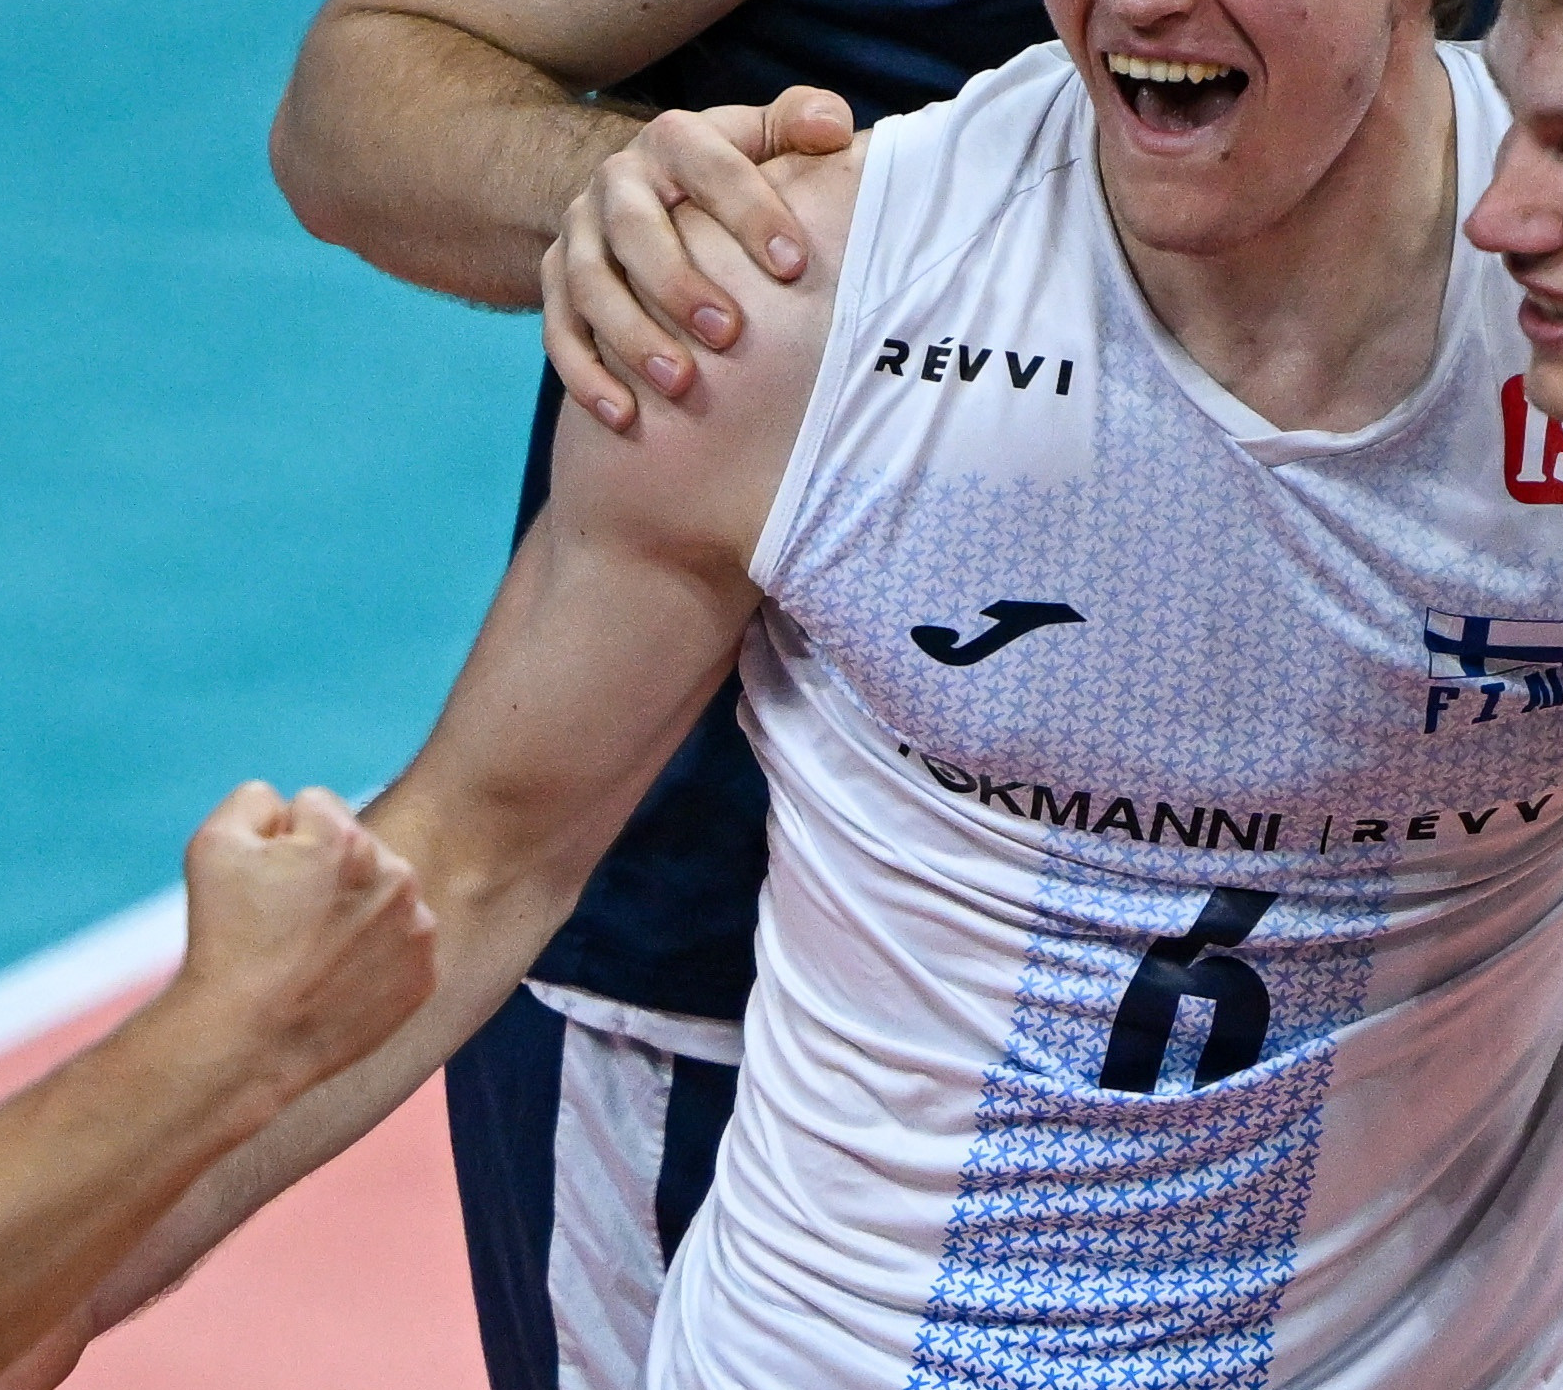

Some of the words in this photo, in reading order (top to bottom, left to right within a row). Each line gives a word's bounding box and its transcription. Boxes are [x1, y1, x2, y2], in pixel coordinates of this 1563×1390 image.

[874, 336, 1074, 396] RÉVVI
[897, 743, 1282, 852] OKMANNI
[1098, 885, 1280, 1096] 6
